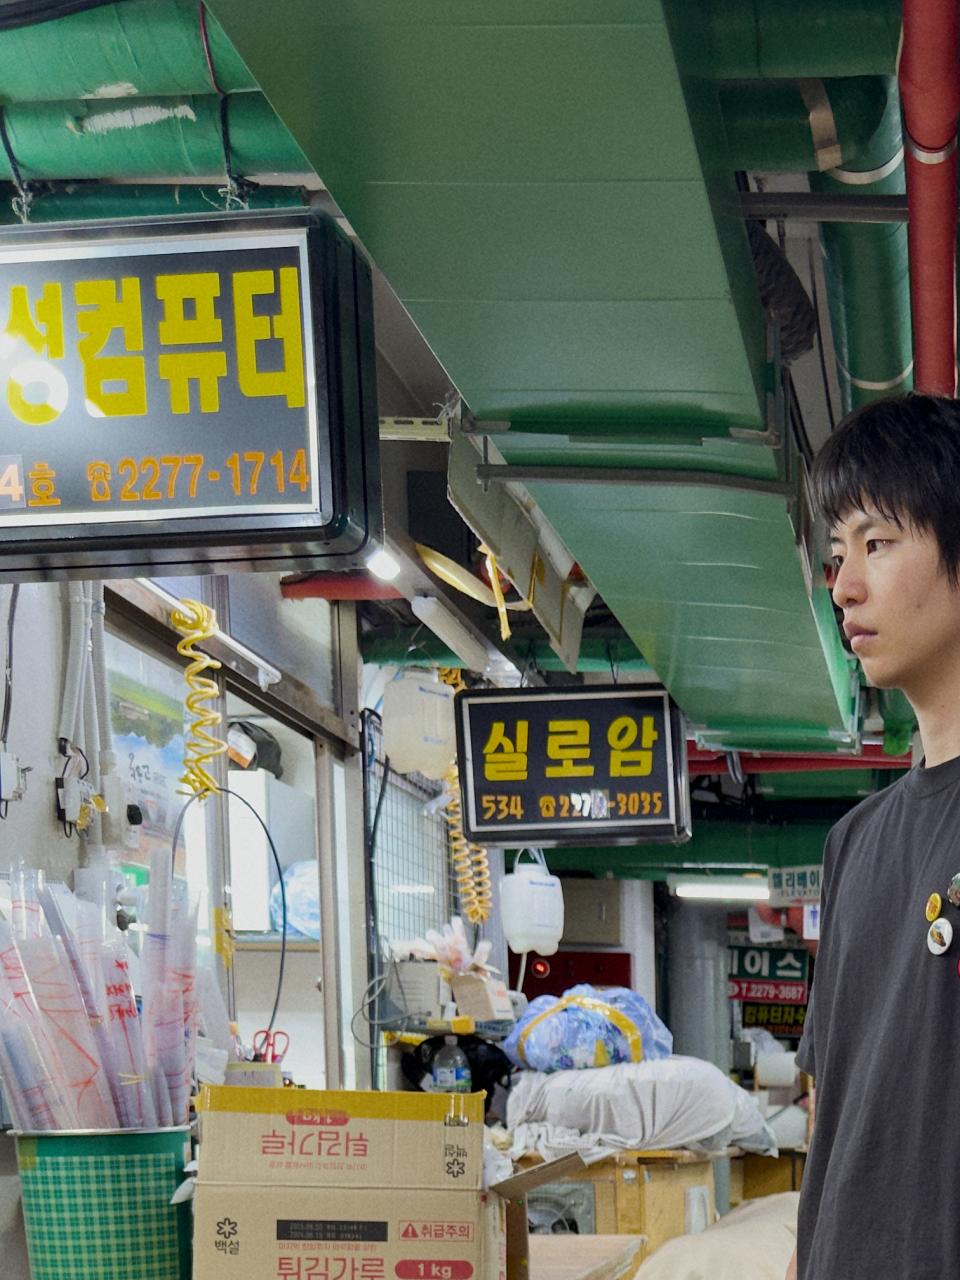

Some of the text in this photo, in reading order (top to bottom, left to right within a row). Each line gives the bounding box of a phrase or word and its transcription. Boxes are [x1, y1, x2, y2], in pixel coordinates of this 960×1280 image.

[118, 448, 311, 501] 2277-1714
[482, 715, 659, 781] 실로암
[482, 795, 524, 820] 534
[261, 1129, 369, 1157] 튀김가루
[420, 1223, 470, 1239] 취급주의
[214, 1240, 239, 1255] 백설
